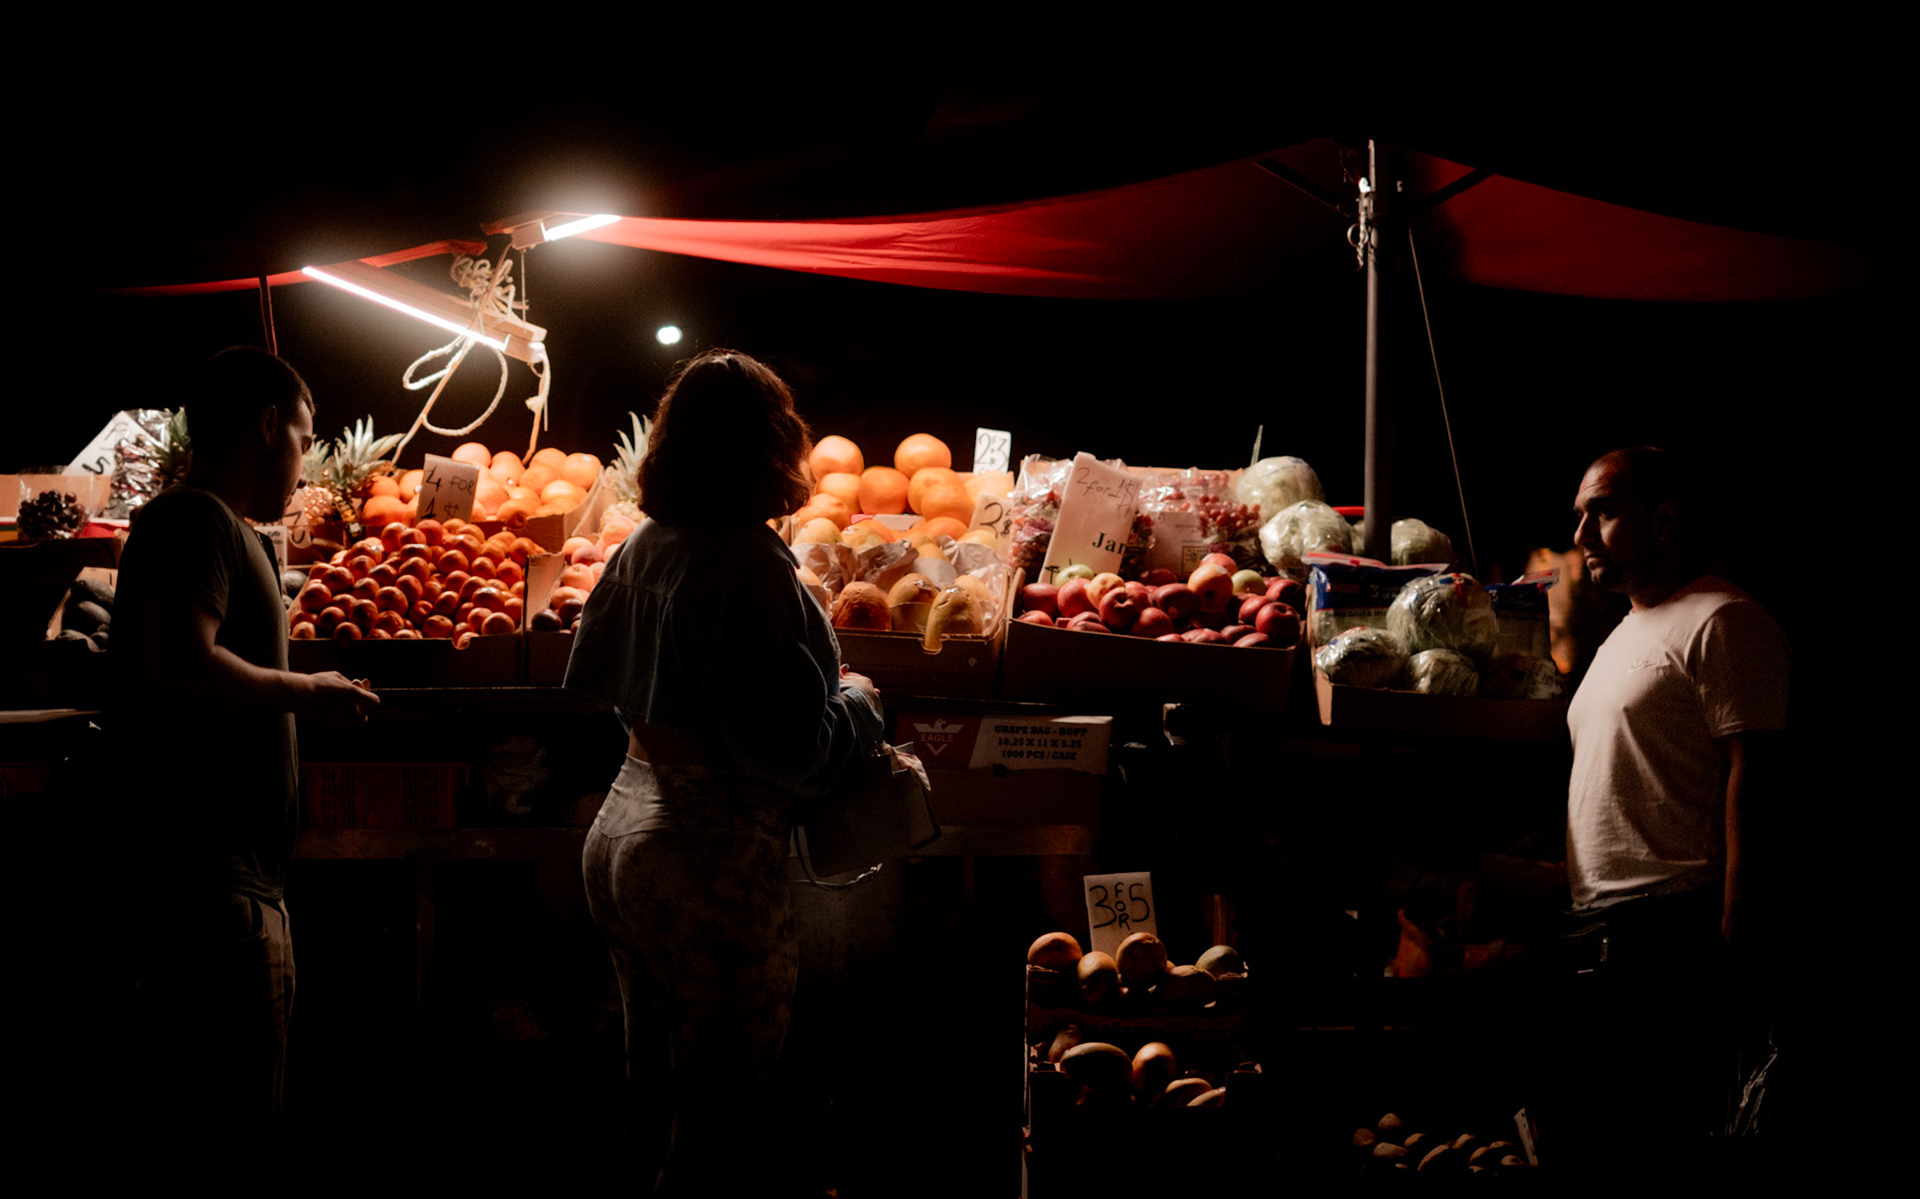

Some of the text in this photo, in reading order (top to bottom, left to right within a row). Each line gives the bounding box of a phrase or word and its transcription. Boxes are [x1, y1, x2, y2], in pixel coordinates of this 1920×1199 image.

[976, 432, 991, 464] 2
[426, 465, 442, 492] 4
[1076, 467, 1090, 485] 2
[920, 733, 954, 743] EAGLE
[995, 725, 1029, 734] GRAPE
[1030, 726, 1051, 735] BAG
[1059, 727, 1088, 737] BOPP
[998, 737, 1024, 746] 10.25
[1001, 750, 1024, 758] 1000
[1026, 750, 1046, 759] PCS
[1052, 751, 1077, 760] CASE
[1089, 885, 1117, 929] 3
[1129, 883, 1150, 922] 5
